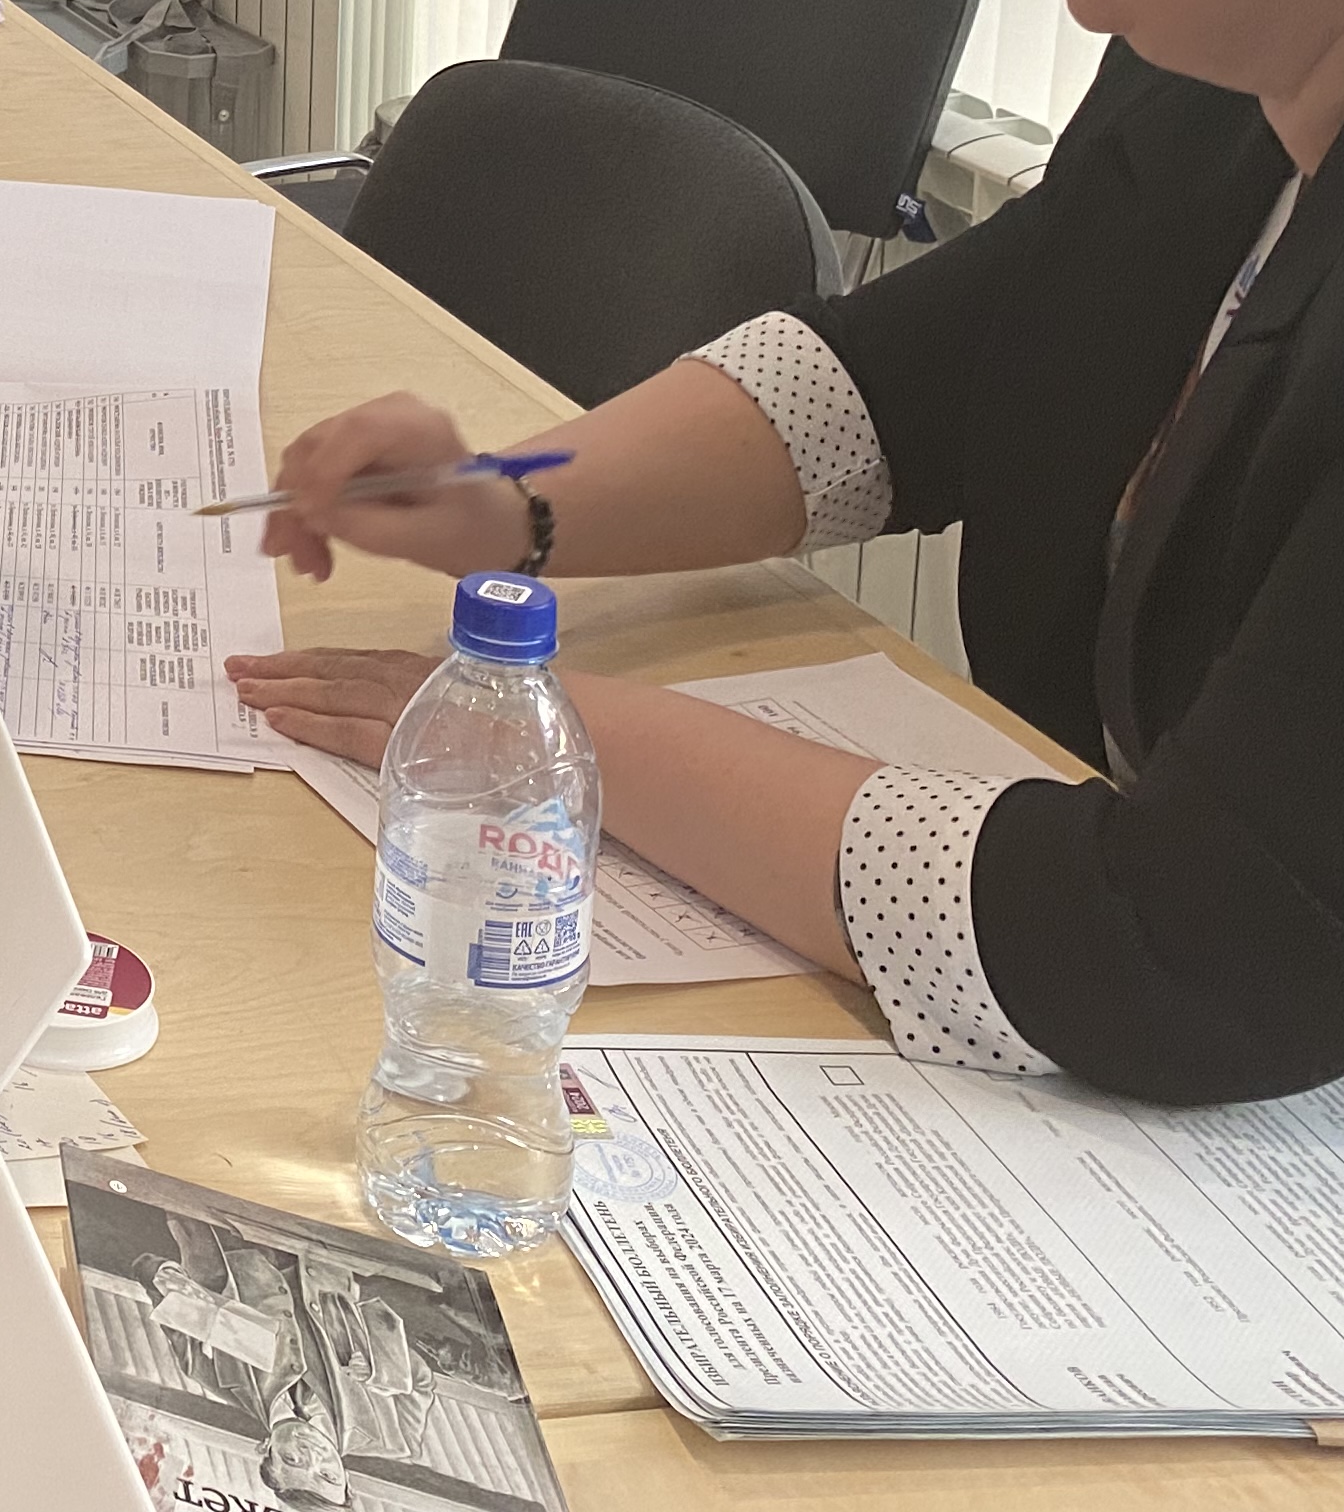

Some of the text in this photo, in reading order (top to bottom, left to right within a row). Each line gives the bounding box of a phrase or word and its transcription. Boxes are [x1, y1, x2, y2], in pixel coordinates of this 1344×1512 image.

[661, 1203, 685, 1224] года
[591, 1200, 651, 1276] БЮЛЛЕТЕНЬ
[673, 1226, 702, 1249] 2024
[697, 1252, 727, 1283] марта
[677, 1263, 734, 1324] Российской
[639, 1280, 730, 1385] ИЗБИРАТЕЛЬНЫЙ
